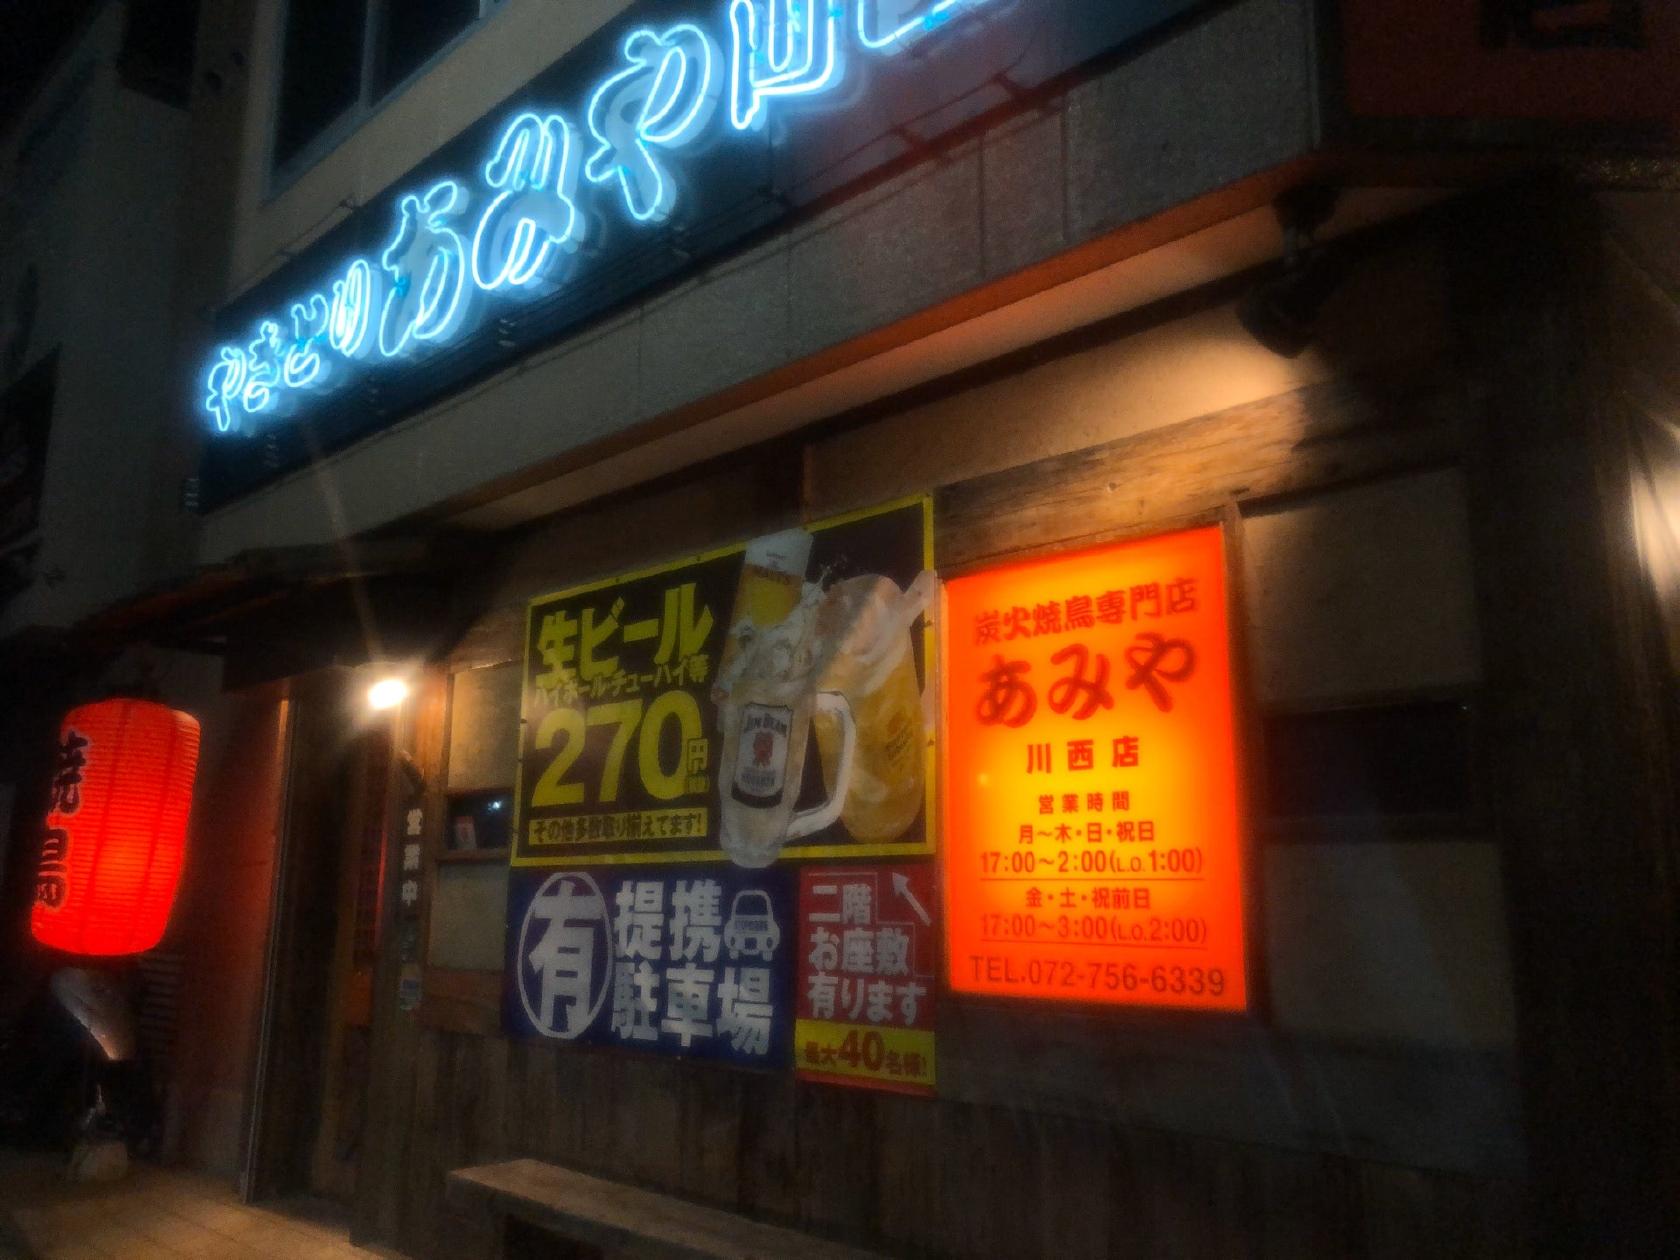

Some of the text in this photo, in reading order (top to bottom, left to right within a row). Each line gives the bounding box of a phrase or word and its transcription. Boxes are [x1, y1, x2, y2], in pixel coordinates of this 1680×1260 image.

[538, 583, 713, 684] 生ビール
[974, 576, 1198, 646] 炭火焼鳥専門店
[976, 631, 1197, 728] あみや
[1026, 735, 1140, 775] 川西店
[1038, 790, 1131, 815] 営業時間
[614, 879, 722, 963] 提携
[808, 884, 872, 926] 二階
[808, 927, 911, 976] お座敷
[610, 961, 774, 1056] 駐車場
[807, 971, 928, 1027] 有ります
